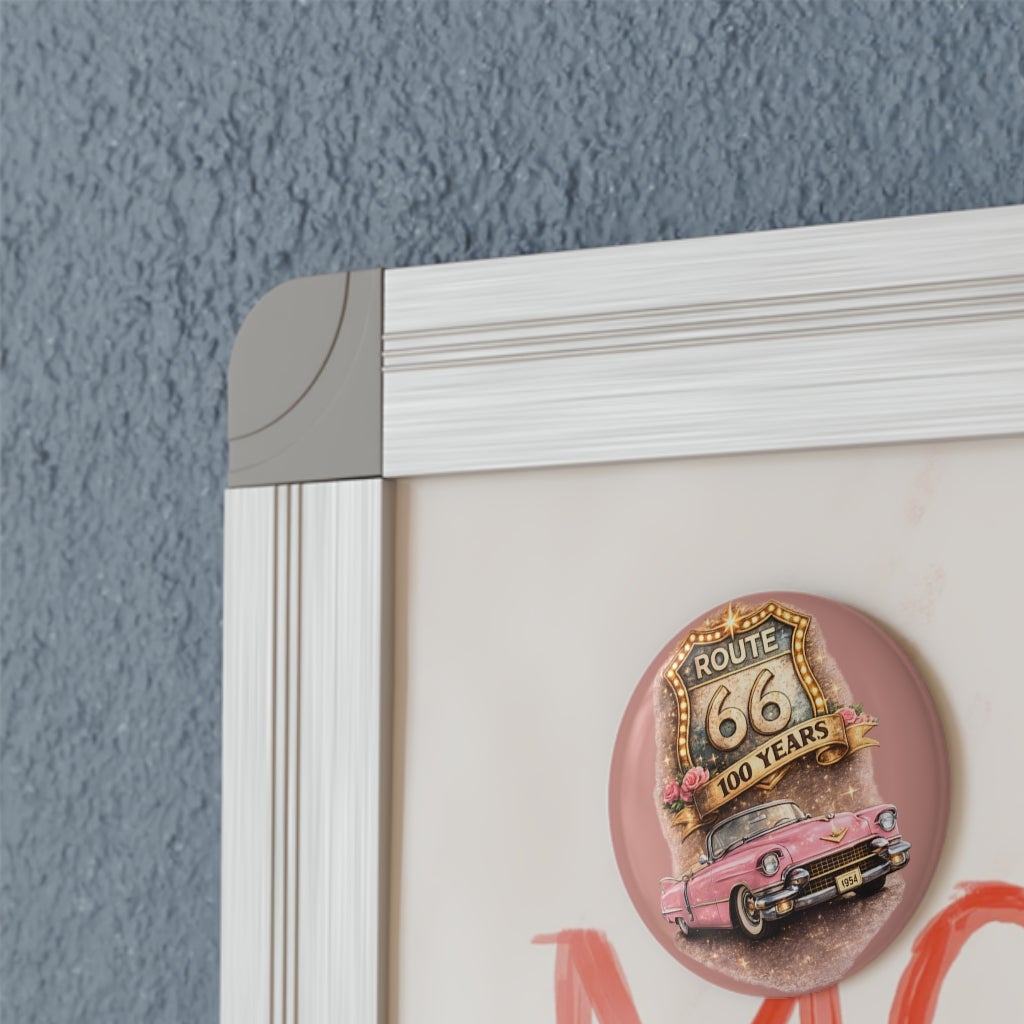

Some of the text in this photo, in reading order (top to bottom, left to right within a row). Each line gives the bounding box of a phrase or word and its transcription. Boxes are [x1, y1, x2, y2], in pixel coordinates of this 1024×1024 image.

[694, 627, 779, 679] ROUTE
[705, 668, 792, 751] 66
[717, 720, 829, 798] 100 YEARS
[841, 874, 859, 889] 1954
